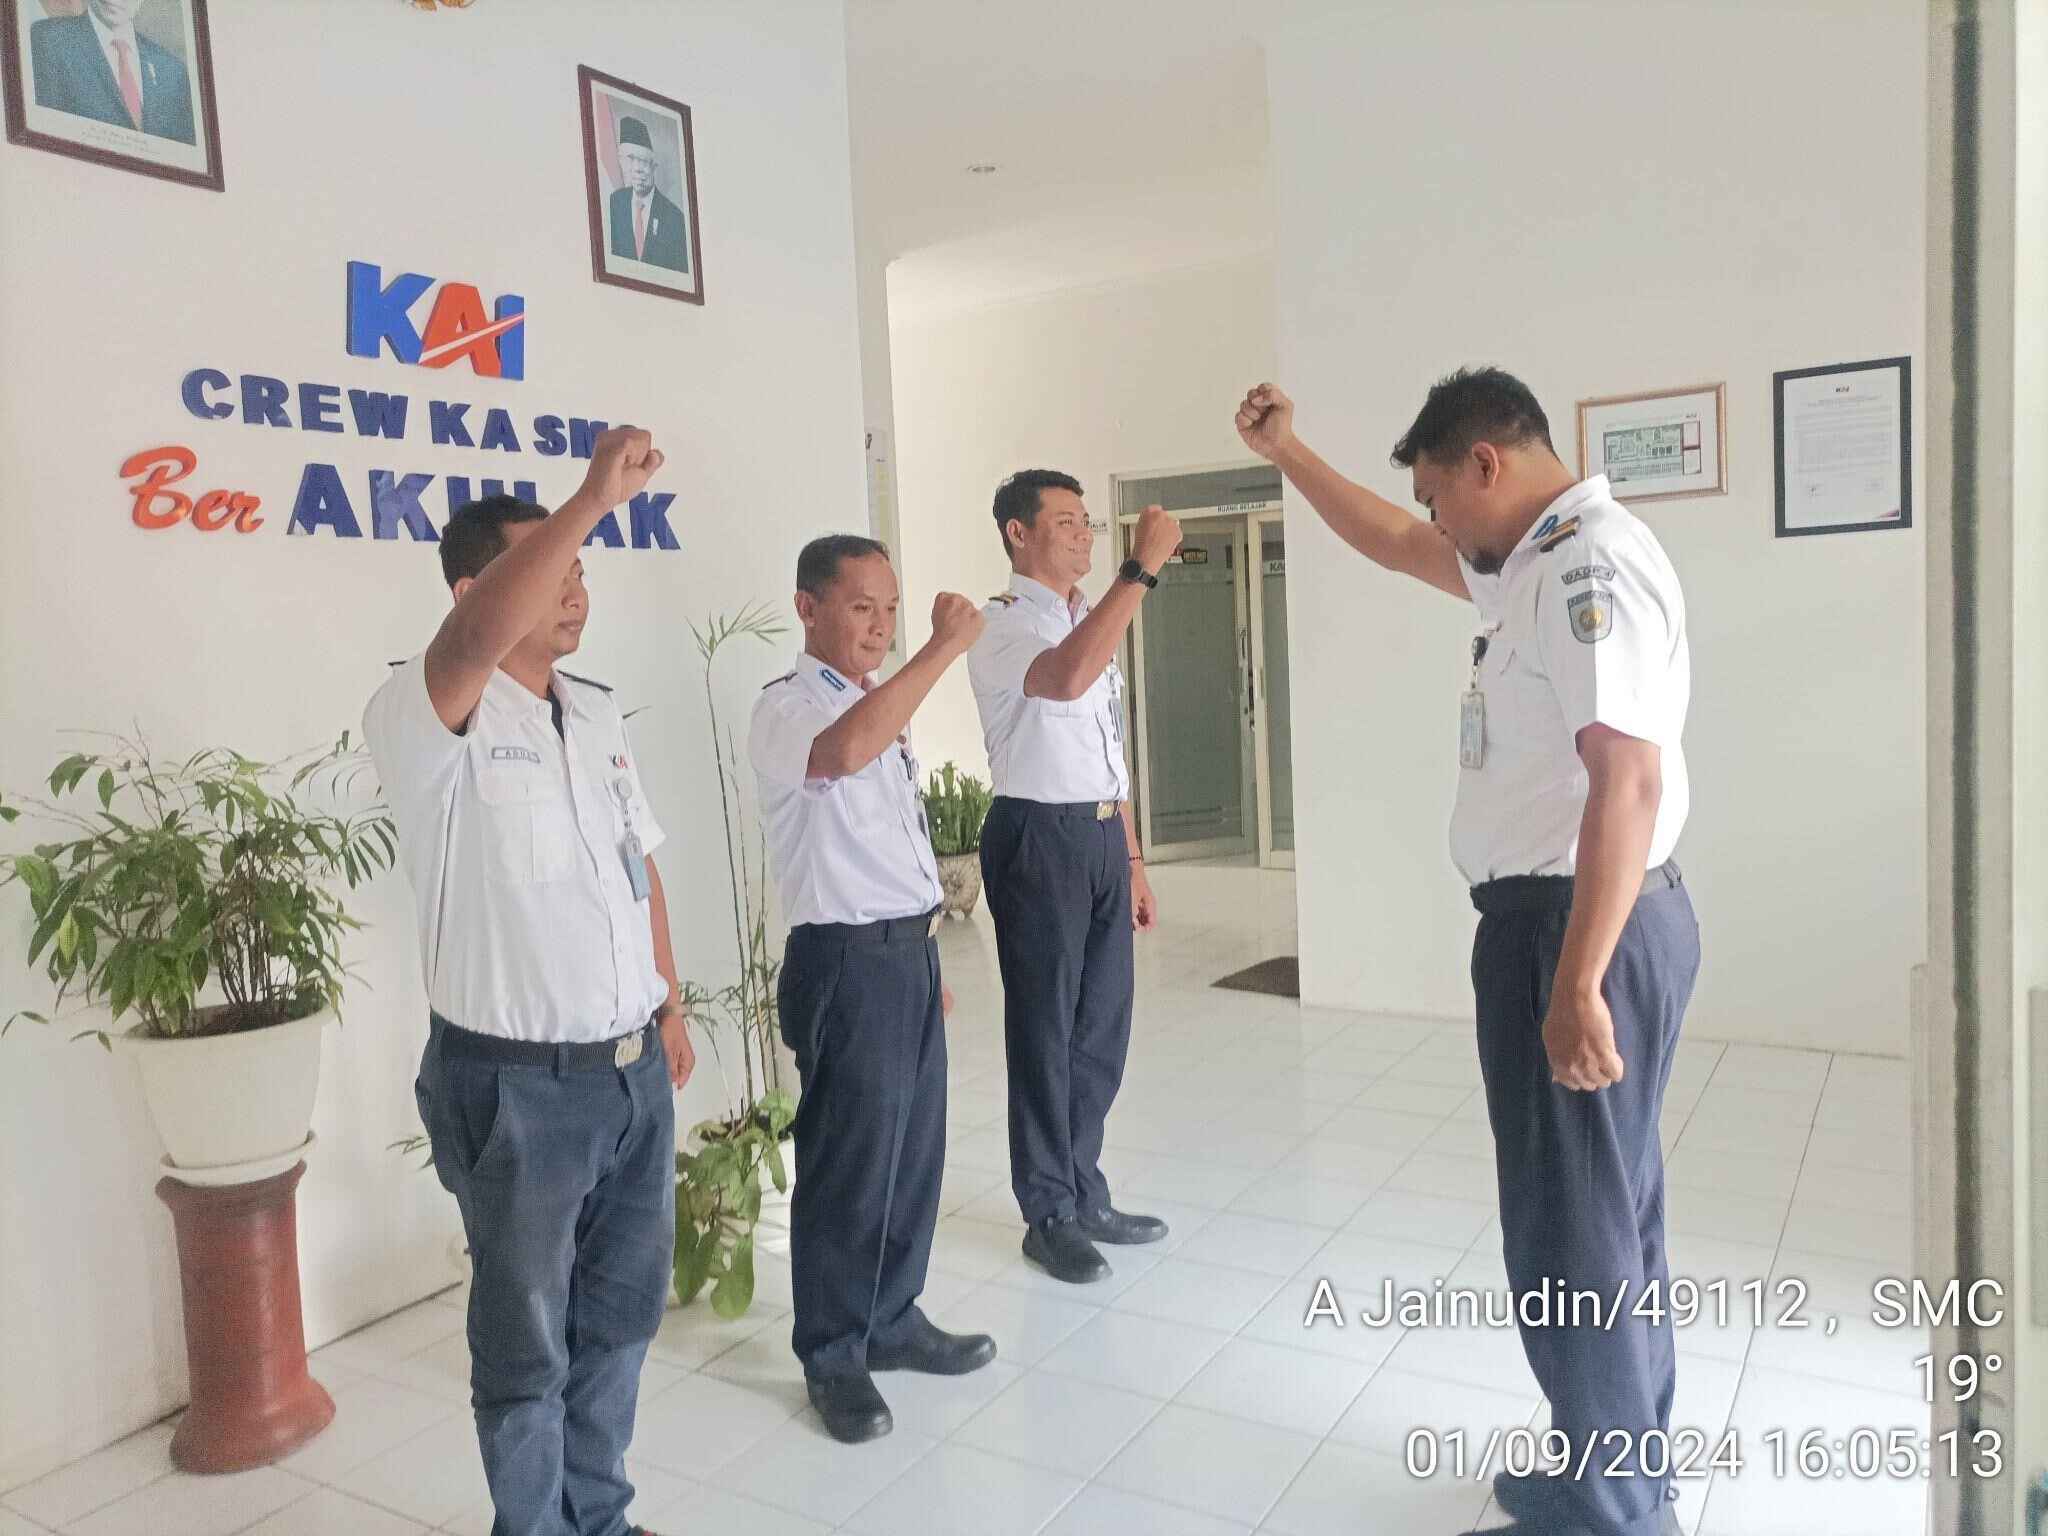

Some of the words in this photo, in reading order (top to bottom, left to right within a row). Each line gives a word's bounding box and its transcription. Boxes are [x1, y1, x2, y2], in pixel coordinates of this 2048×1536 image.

[346, 261, 525, 382] KAI
[181, 368, 409, 440] CREW
[533, 414, 612, 461] SM
[119, 445, 264, 534] Ber
